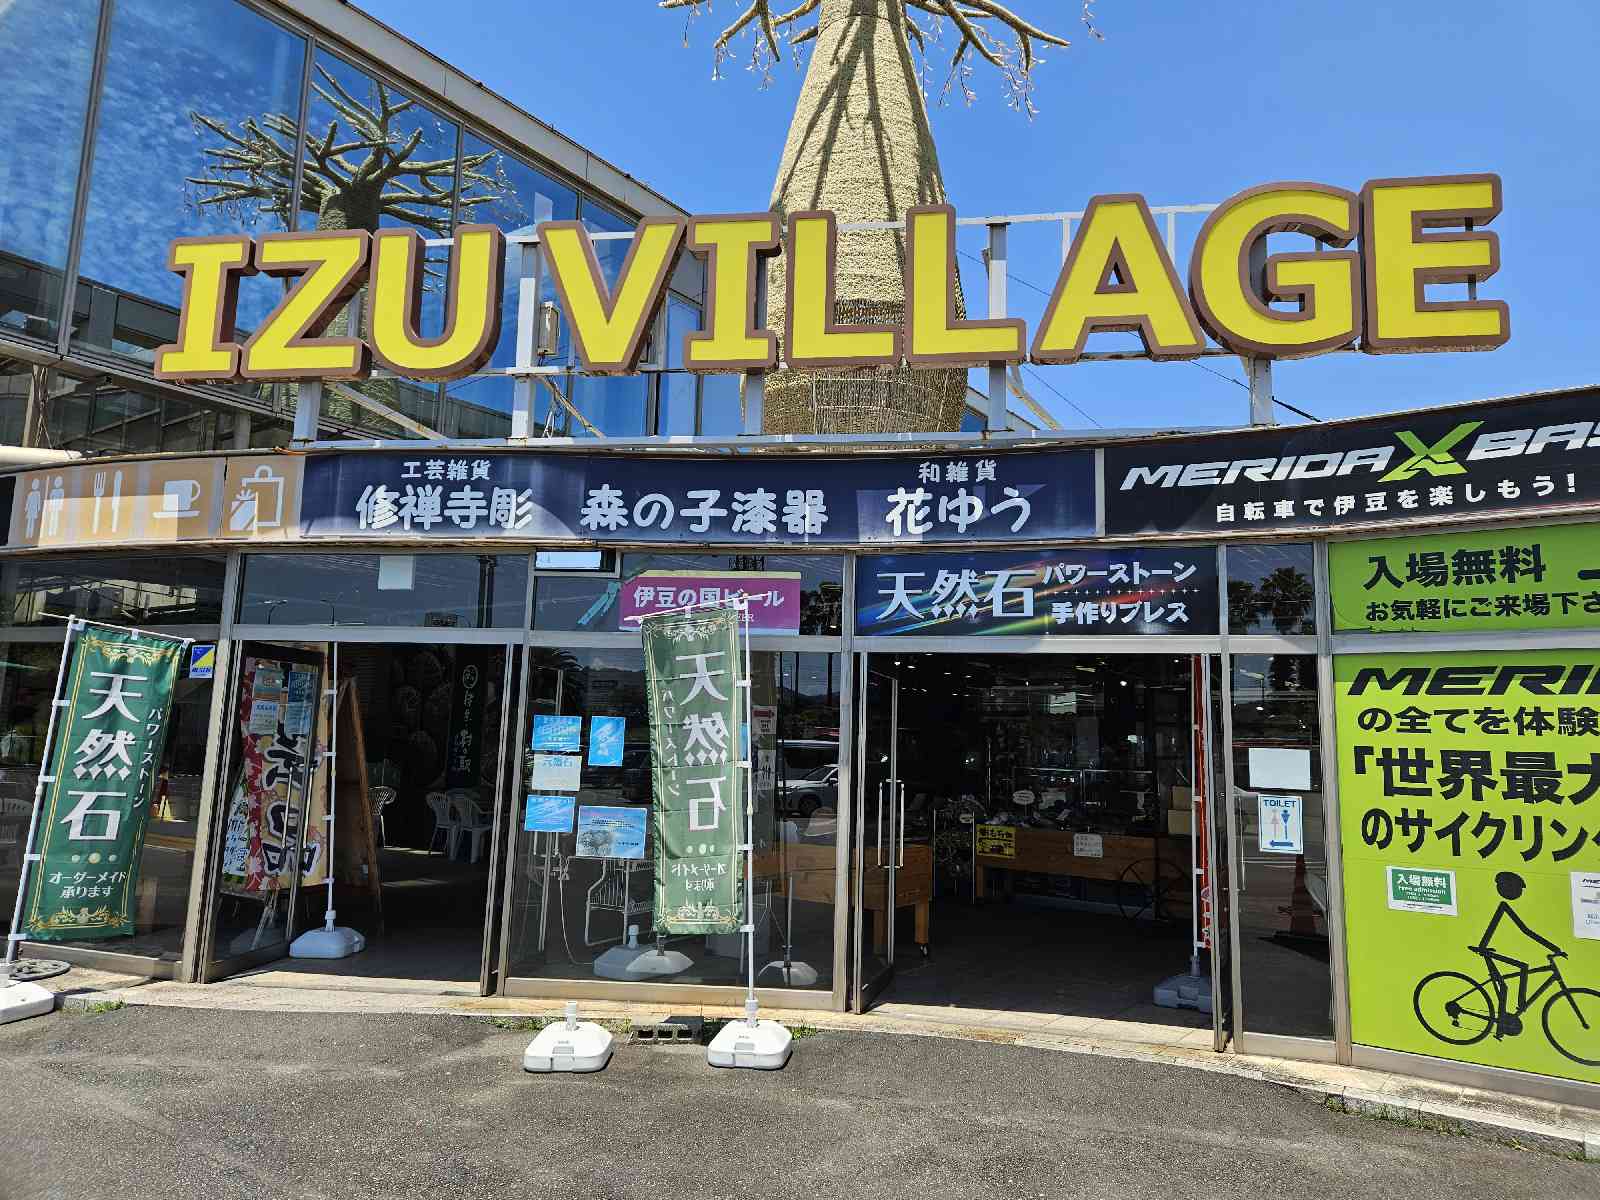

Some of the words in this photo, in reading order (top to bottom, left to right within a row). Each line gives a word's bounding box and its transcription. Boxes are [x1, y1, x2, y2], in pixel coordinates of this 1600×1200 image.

[153, 228, 502, 379] IZU
[538, 172, 1510, 376] VILLAGE
[400, 459, 493, 482] 工芸雑貨
[918, 459, 998, 484] 和雑貨
[1119, 445, 1396, 492] MERIDA
[1465, 420, 1600, 461] BA
[355, 485, 535, 532] 修禅寺彫
[580, 486, 829, 536] 森の子漆器
[885, 486, 1034, 537] 花ゆう
[1215, 472, 1577, 524] 自転車で伊豆を楽しもう！
[1042, 561, 1198, 586] パワーストーン
[1362, 543, 1546, 590] 入場無料
[876, 568, 1036, 621] 天然石
[1347, 664, 1600, 696] MERI
[1357, 706, 1600, 737] の全てを体験
[60, 670, 149, 842] 天然石
[132, 706, 165, 810] パワーストーン
[1262, 798, 1297, 809] TOILET
[1361, 807, 1600, 862] のサイクリン
[48, 871, 127, 884] オーダーメイド
[60, 885, 115, 898] 承ります
[1396, 873, 1446, 888] 入場無料
